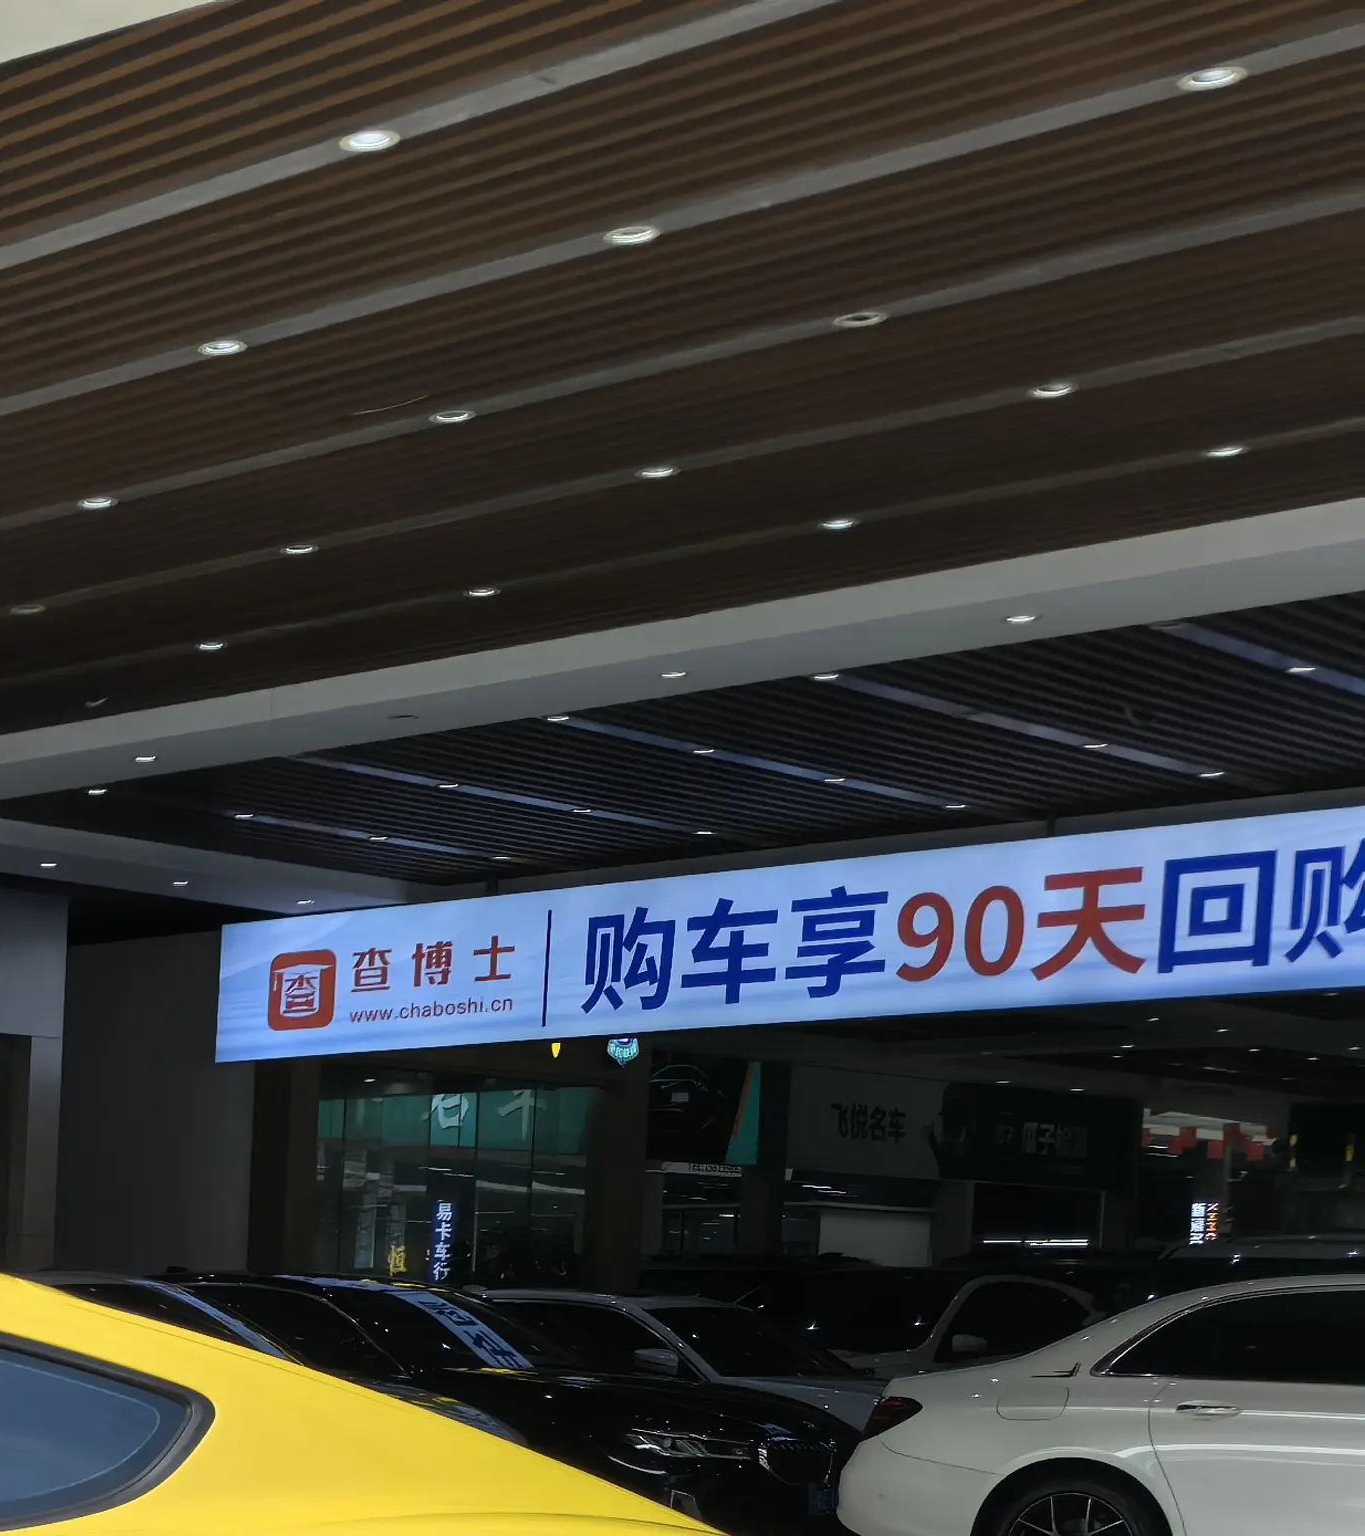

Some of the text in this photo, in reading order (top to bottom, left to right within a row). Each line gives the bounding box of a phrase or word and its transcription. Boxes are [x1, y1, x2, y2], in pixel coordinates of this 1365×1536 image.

[350, 935, 516, 994] 查博士
[580, 845, 1365, 1014] 购车享90天回购
[349, 996, 514, 1024] www.chaboshi.cn
[432, 1199, 454, 1282] 易卡车行
